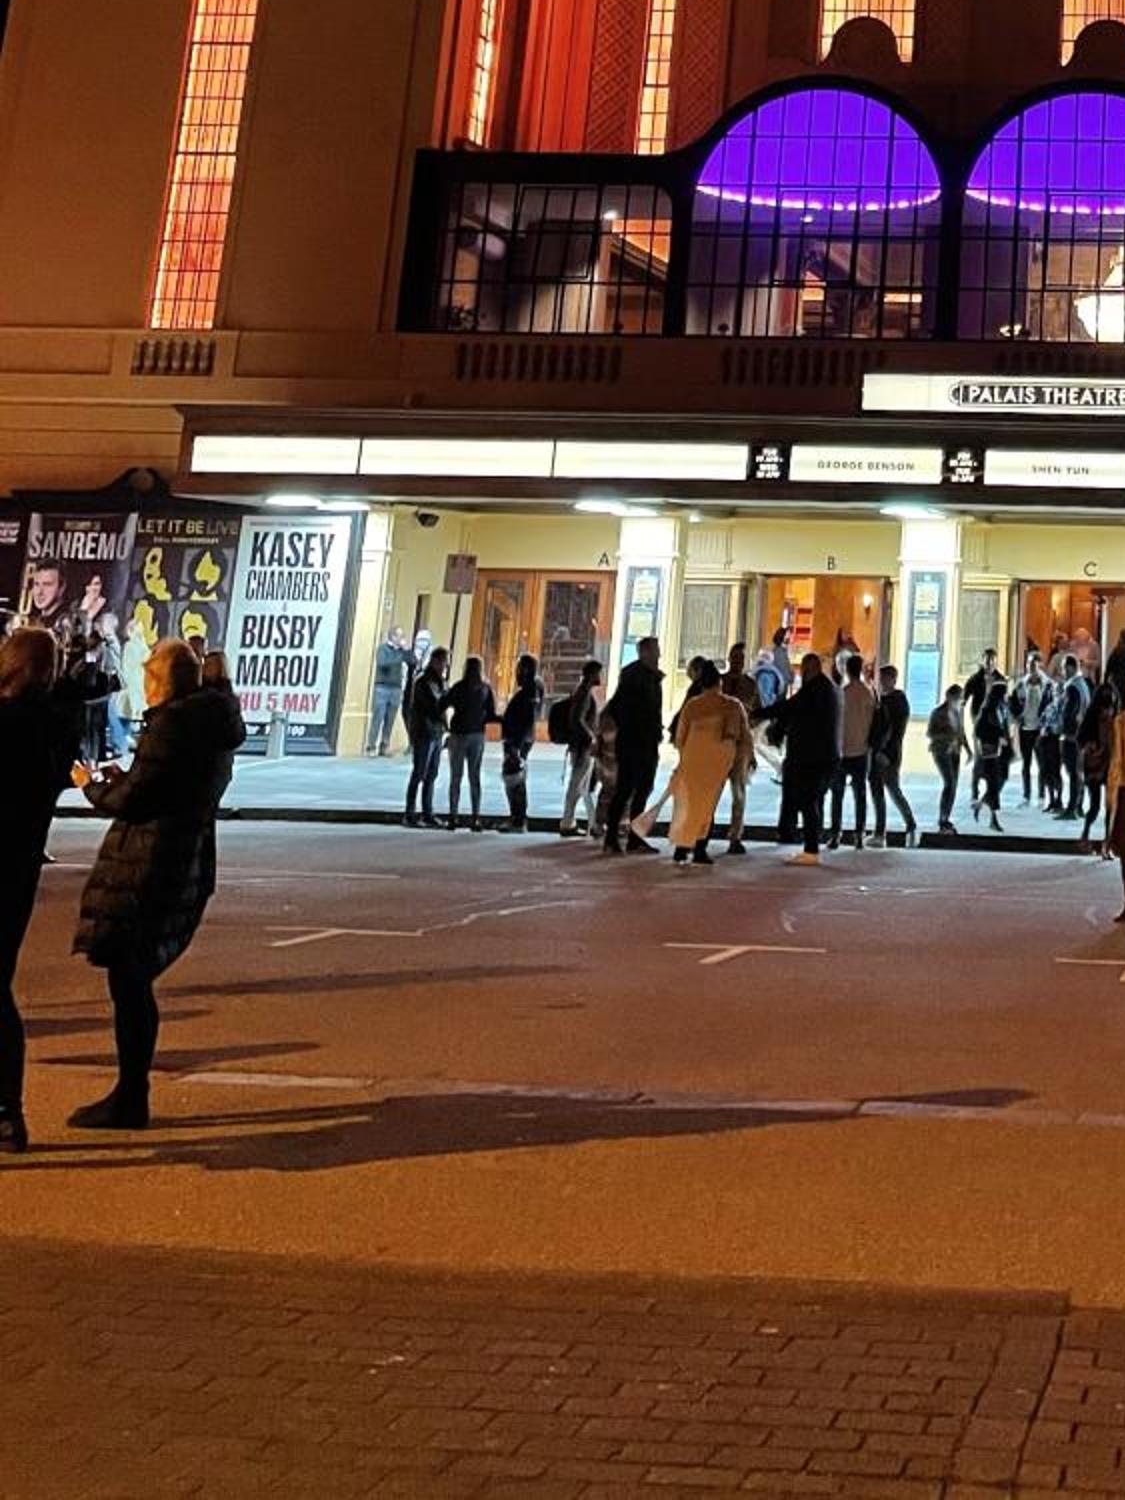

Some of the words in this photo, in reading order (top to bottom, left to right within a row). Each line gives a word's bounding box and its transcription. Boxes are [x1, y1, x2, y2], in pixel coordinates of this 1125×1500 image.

[968, 385, 1036, 404] PALAIS
[137, 519, 166, 533] LET
[167, 519, 185, 534] IT
[186, 520, 205, 535] BE
[28, 531, 128, 560] SANREMO
[249, 531, 336, 569] KASEY
[597, 551, 611, 567] A
[827, 555, 837, 571] B
[1083, 560, 1097, 577] C
[245, 569, 332, 603] CHAMBERS
[239, 614, 323, 650] BUSBY
[235, 654, 319, 687] MAROU
[239, 691, 262, 711] HU
[267, 692, 278, 711] 5
[283, 692, 321, 714] MAY
